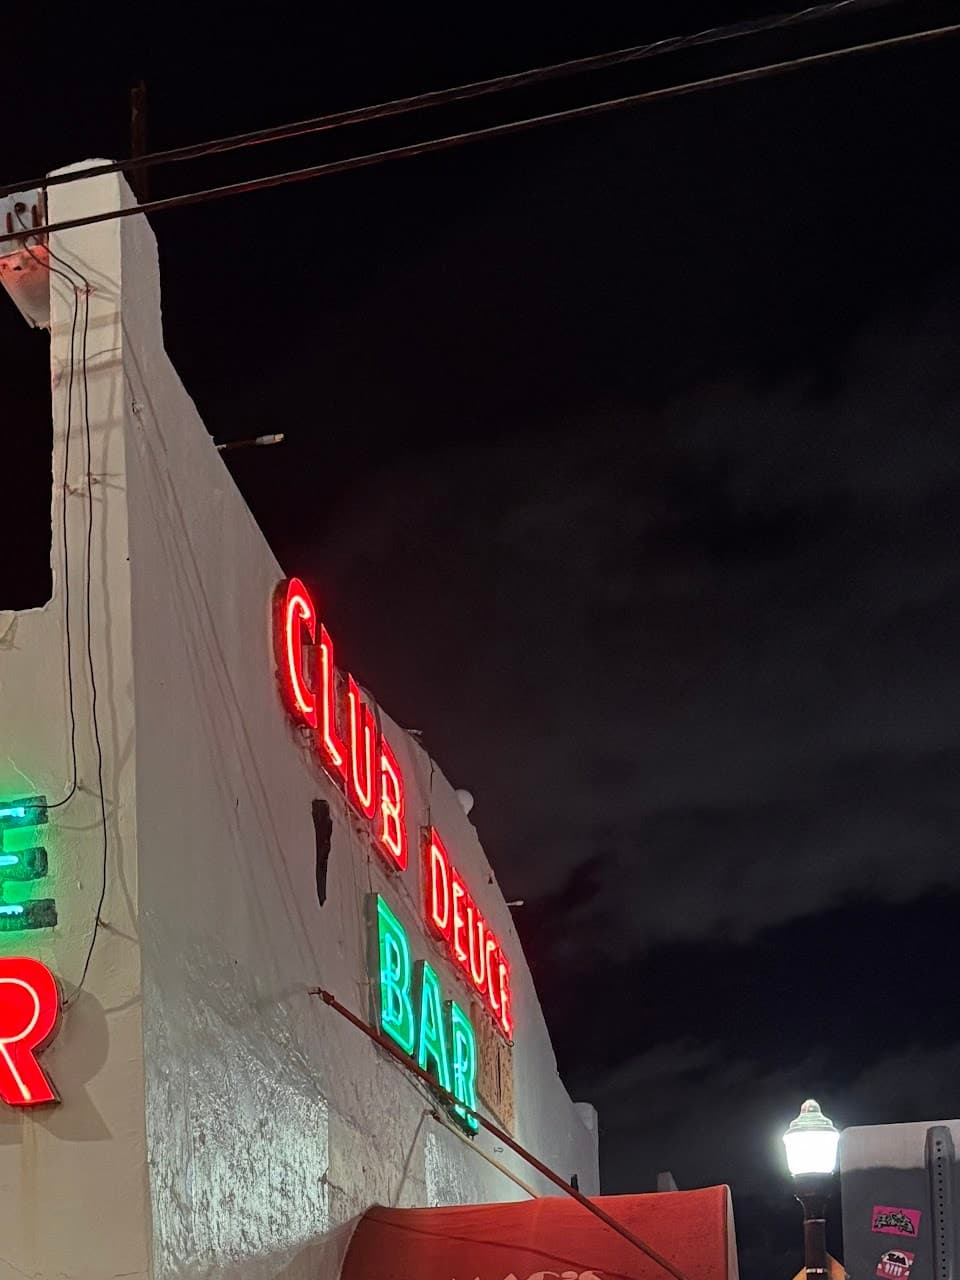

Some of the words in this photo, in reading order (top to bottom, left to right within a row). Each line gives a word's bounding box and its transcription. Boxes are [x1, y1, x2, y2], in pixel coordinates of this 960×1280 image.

[274, 577, 408, 873] CLUB
[422, 826, 514, 1046] DEUCE
[368, 893, 479, 1136] BAR
